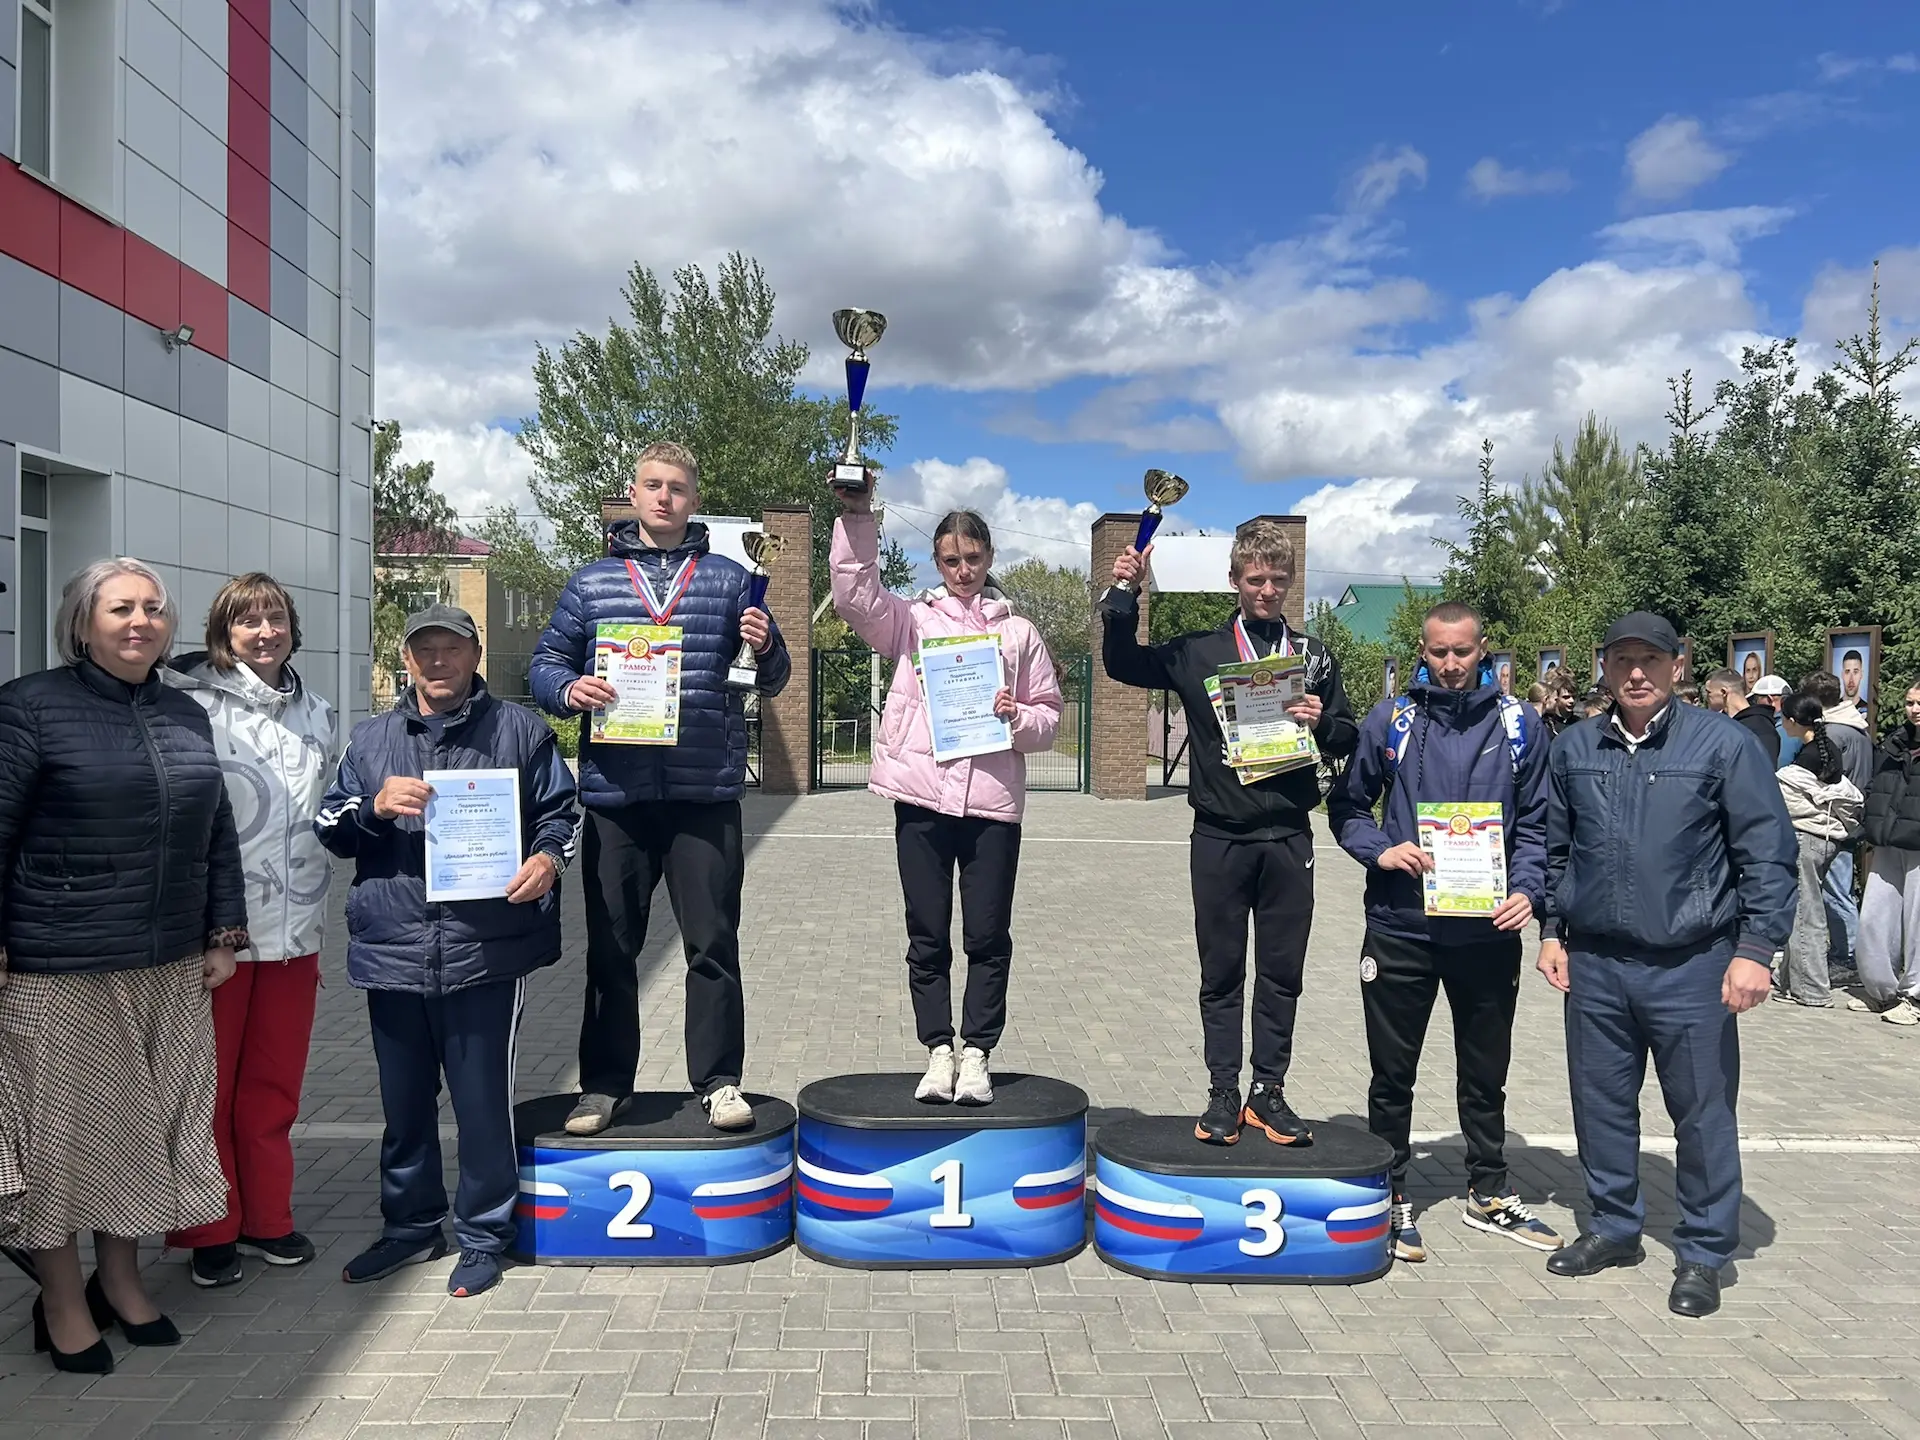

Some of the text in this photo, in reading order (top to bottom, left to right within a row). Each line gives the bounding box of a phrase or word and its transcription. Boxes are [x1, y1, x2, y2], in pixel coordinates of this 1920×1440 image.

[944, 675, 984, 684] СЕРТИФИКАТ
[1245, 689, 1282, 698] ГРАМОТА
[606, 1170, 655, 1240] 2
[929, 1160, 973, 1229] 1
[1238, 1189, 1287, 1258] 3
